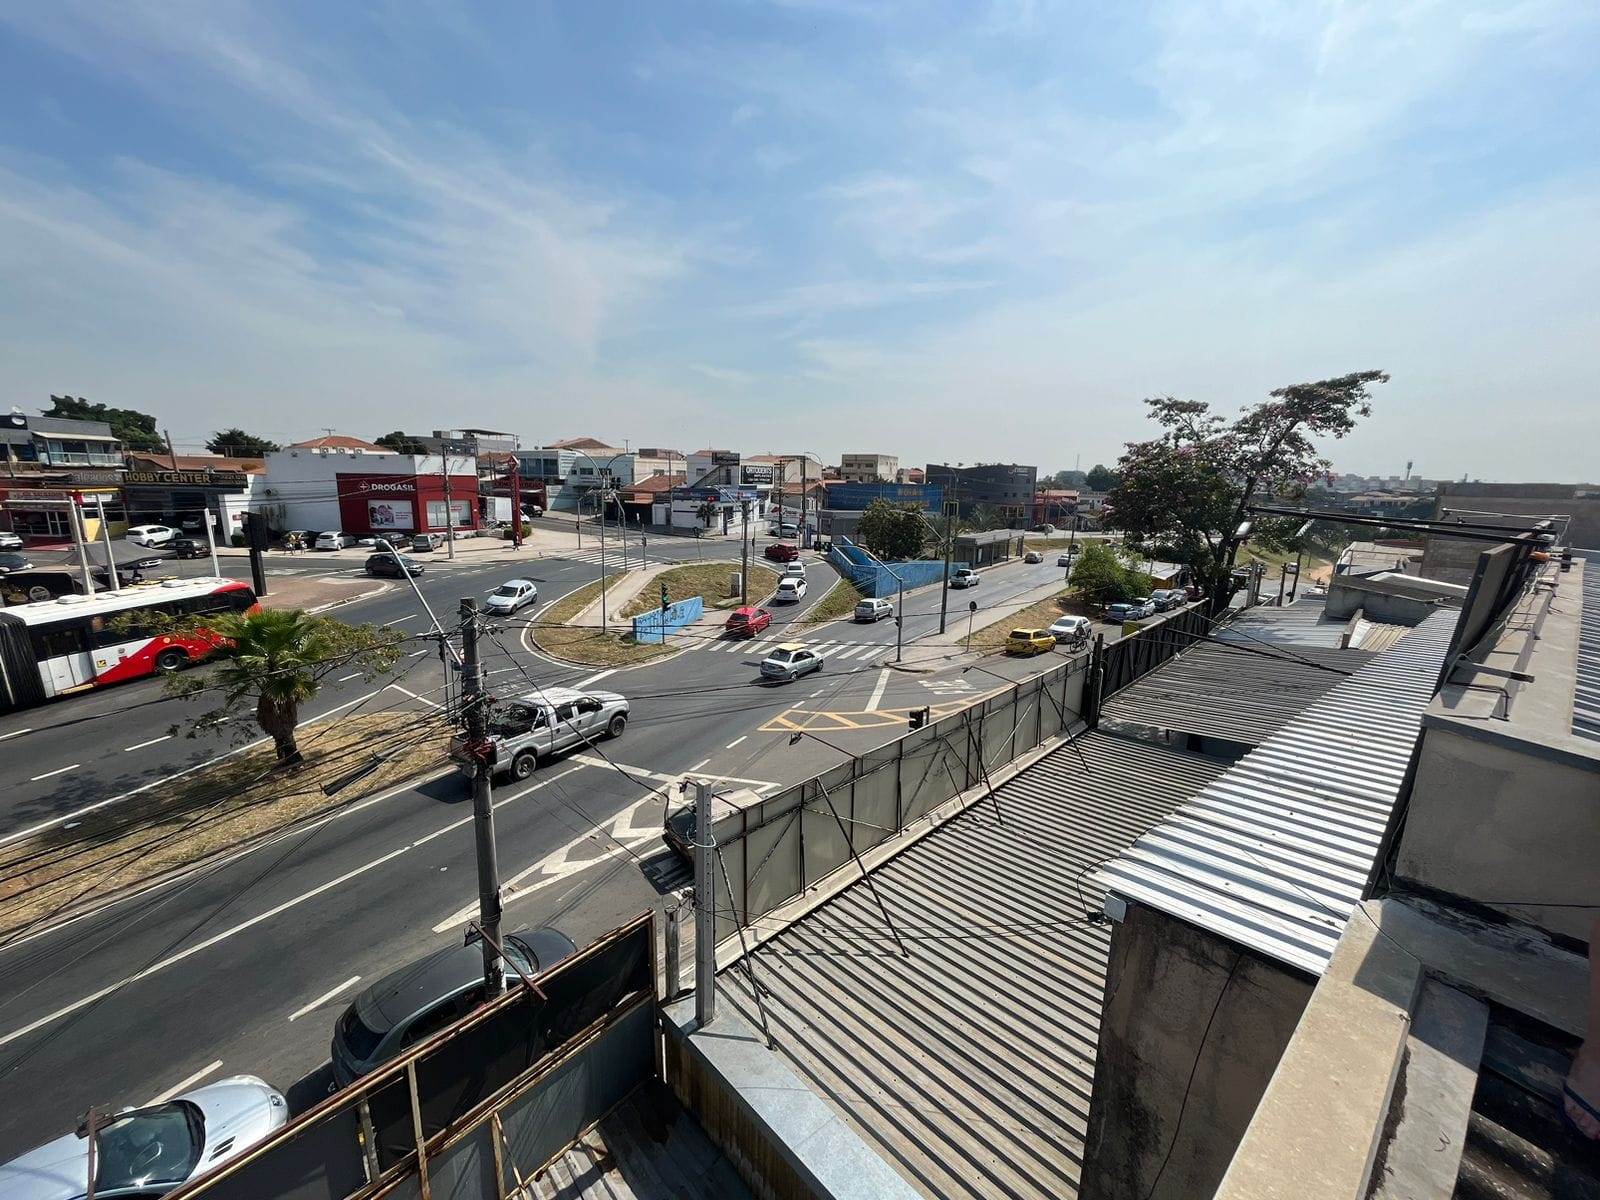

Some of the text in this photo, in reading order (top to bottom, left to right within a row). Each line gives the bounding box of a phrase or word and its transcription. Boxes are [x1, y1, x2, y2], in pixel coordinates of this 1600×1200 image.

[125, 472, 160, 483] HOBBY
[163, 473, 212, 483] CENTER
[371, 483, 416, 491] DROGASIL
